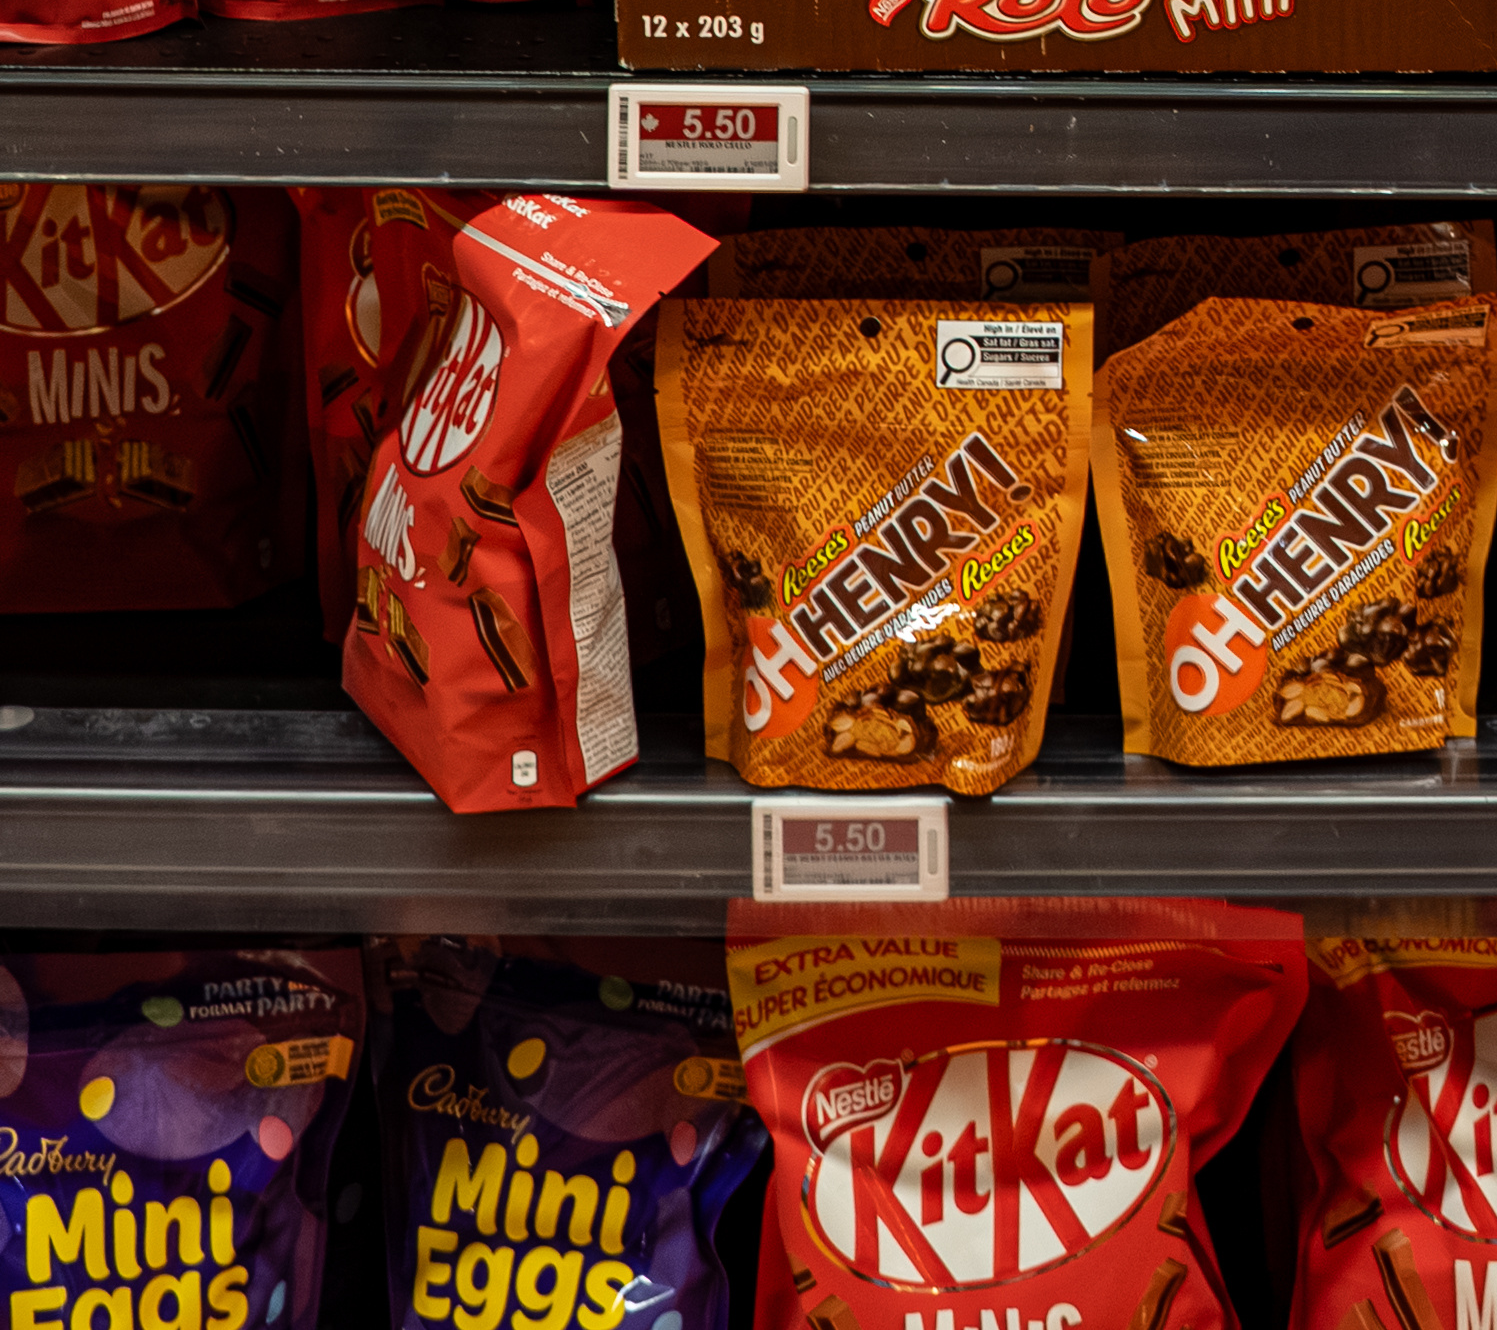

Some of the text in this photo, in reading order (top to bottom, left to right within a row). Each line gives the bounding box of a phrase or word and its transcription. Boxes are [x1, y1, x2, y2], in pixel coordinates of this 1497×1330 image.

[643, 16, 764, 44] 12 x 203 g
[682, 110, 755, 139] 5.50
[855, 492, 893, 537] PEANUT
[895, 455, 935, 500] BUTTER
[791, 433, 1031, 660] HENRY!
[814, 822, 886, 852] 5.50
[847, 1047, 1153, 1284] KitKat
[25, 1159, 235, 1284] Mini
